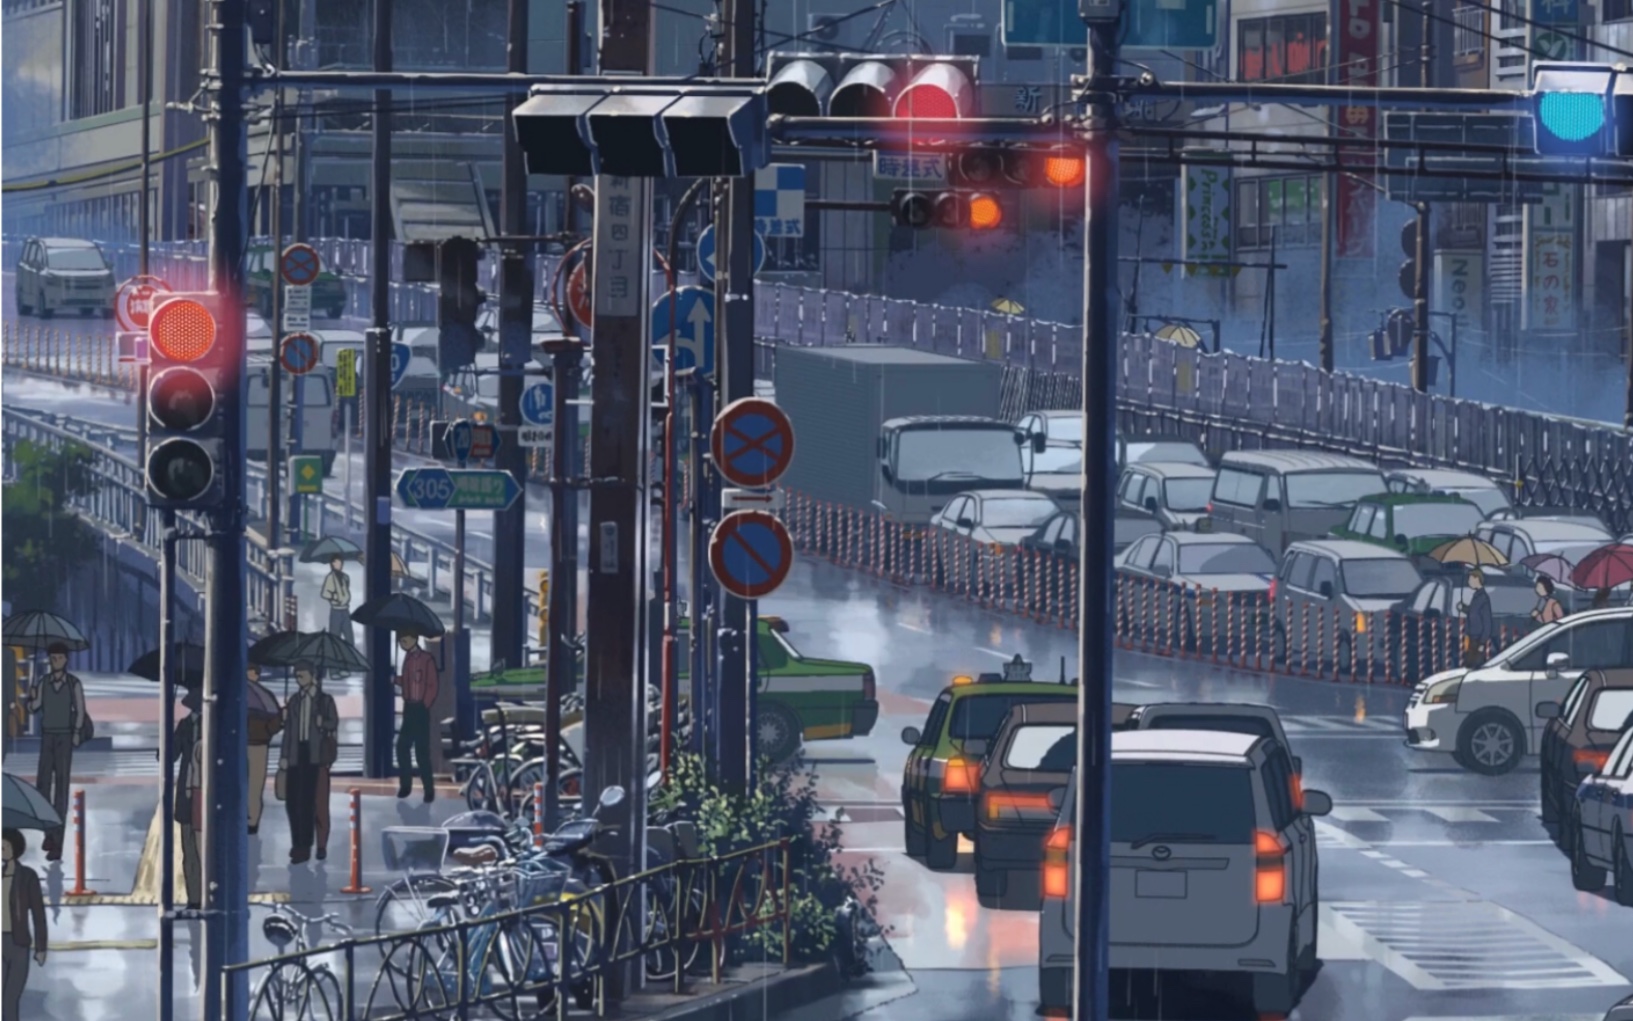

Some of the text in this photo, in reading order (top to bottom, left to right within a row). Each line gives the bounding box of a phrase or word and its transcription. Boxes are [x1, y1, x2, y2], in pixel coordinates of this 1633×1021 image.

[879, 157, 942, 178] 時差式
[414, 479, 450, 500] 305
